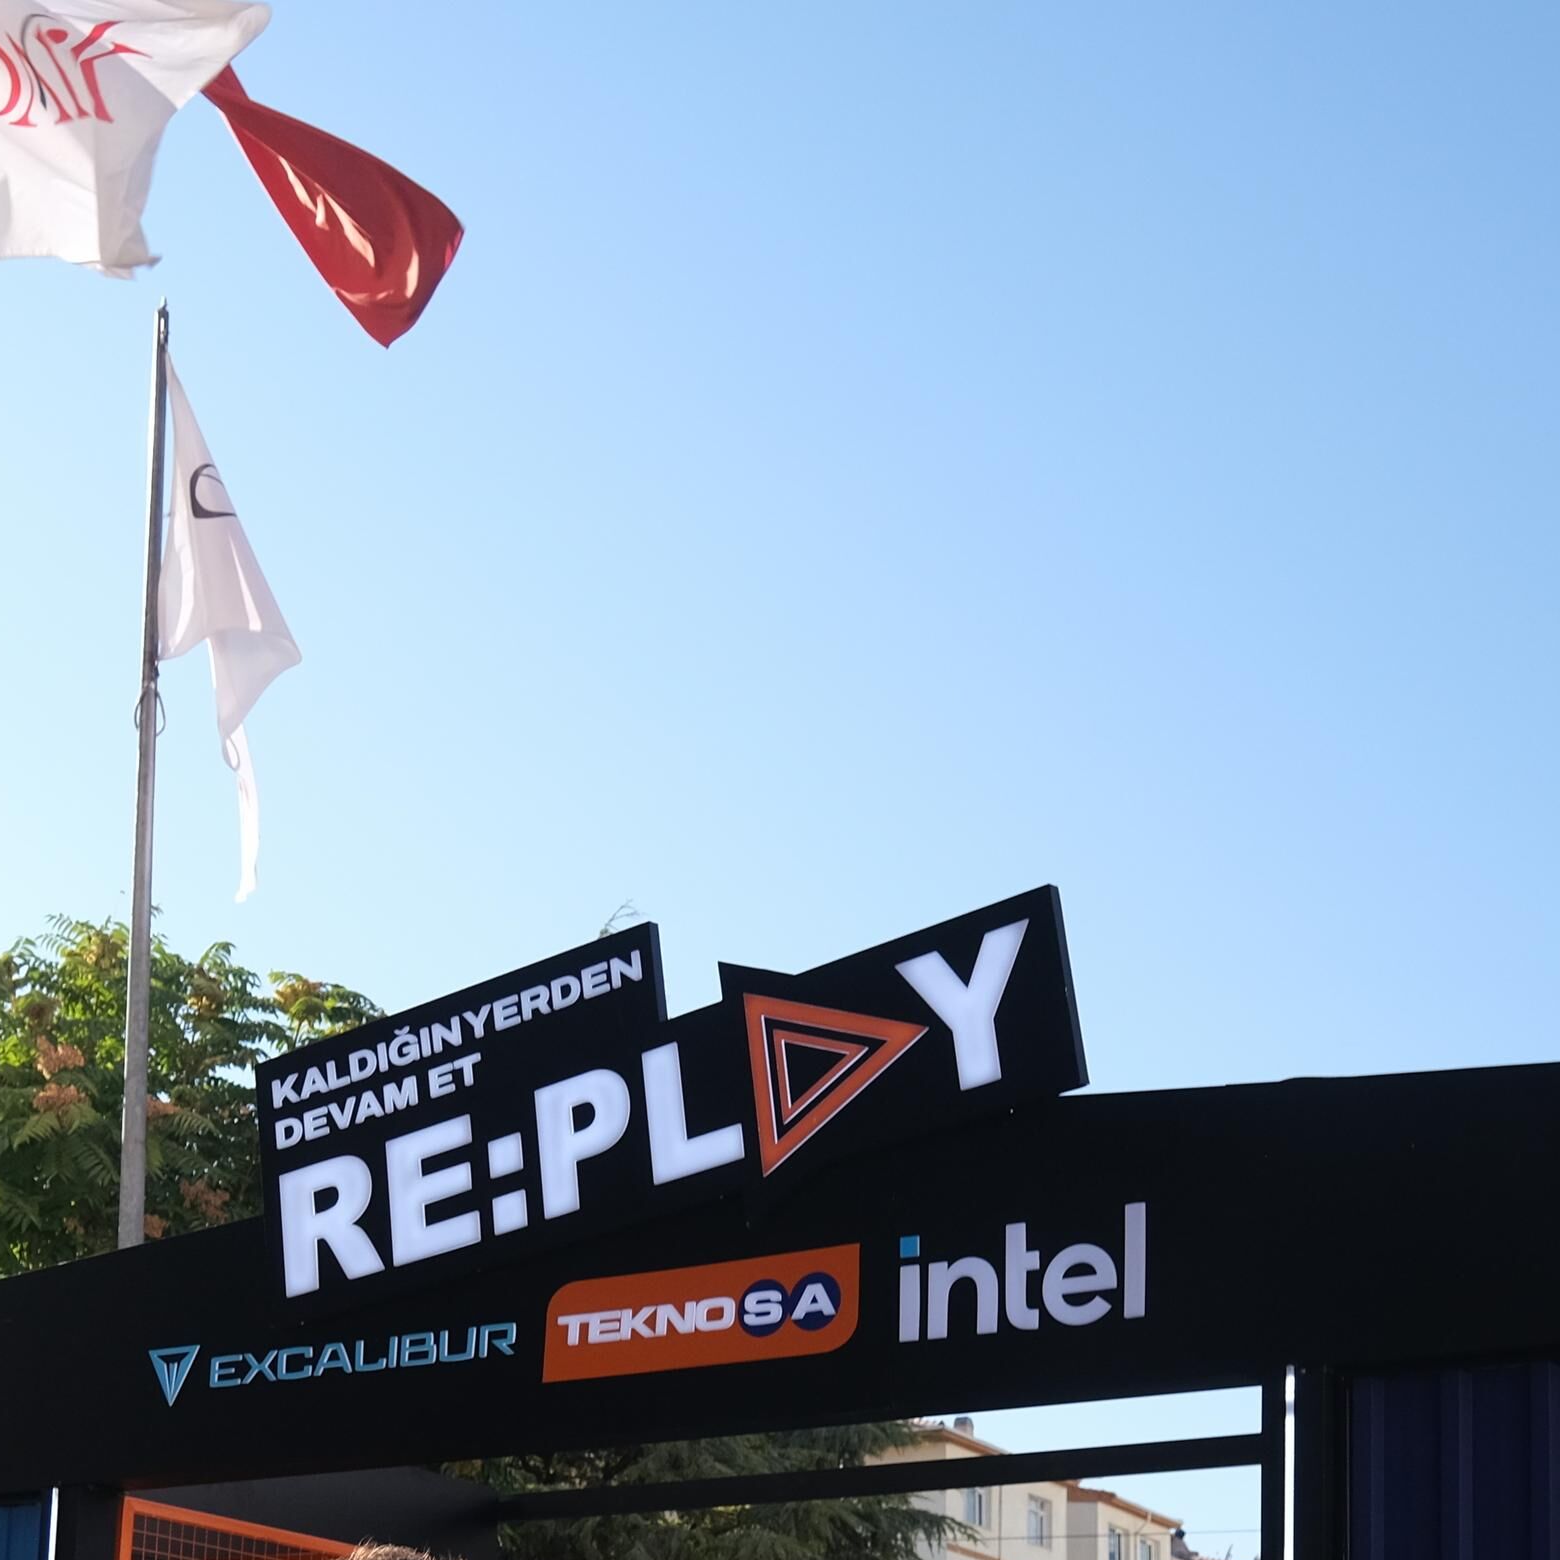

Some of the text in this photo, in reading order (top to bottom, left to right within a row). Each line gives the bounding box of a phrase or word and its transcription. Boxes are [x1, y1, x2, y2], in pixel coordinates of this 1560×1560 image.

[274, 1052, 482, 1150] DEVAM ET
[209, 1202, 1146, 1388] EXCALIBUR TEKNOSA intel
